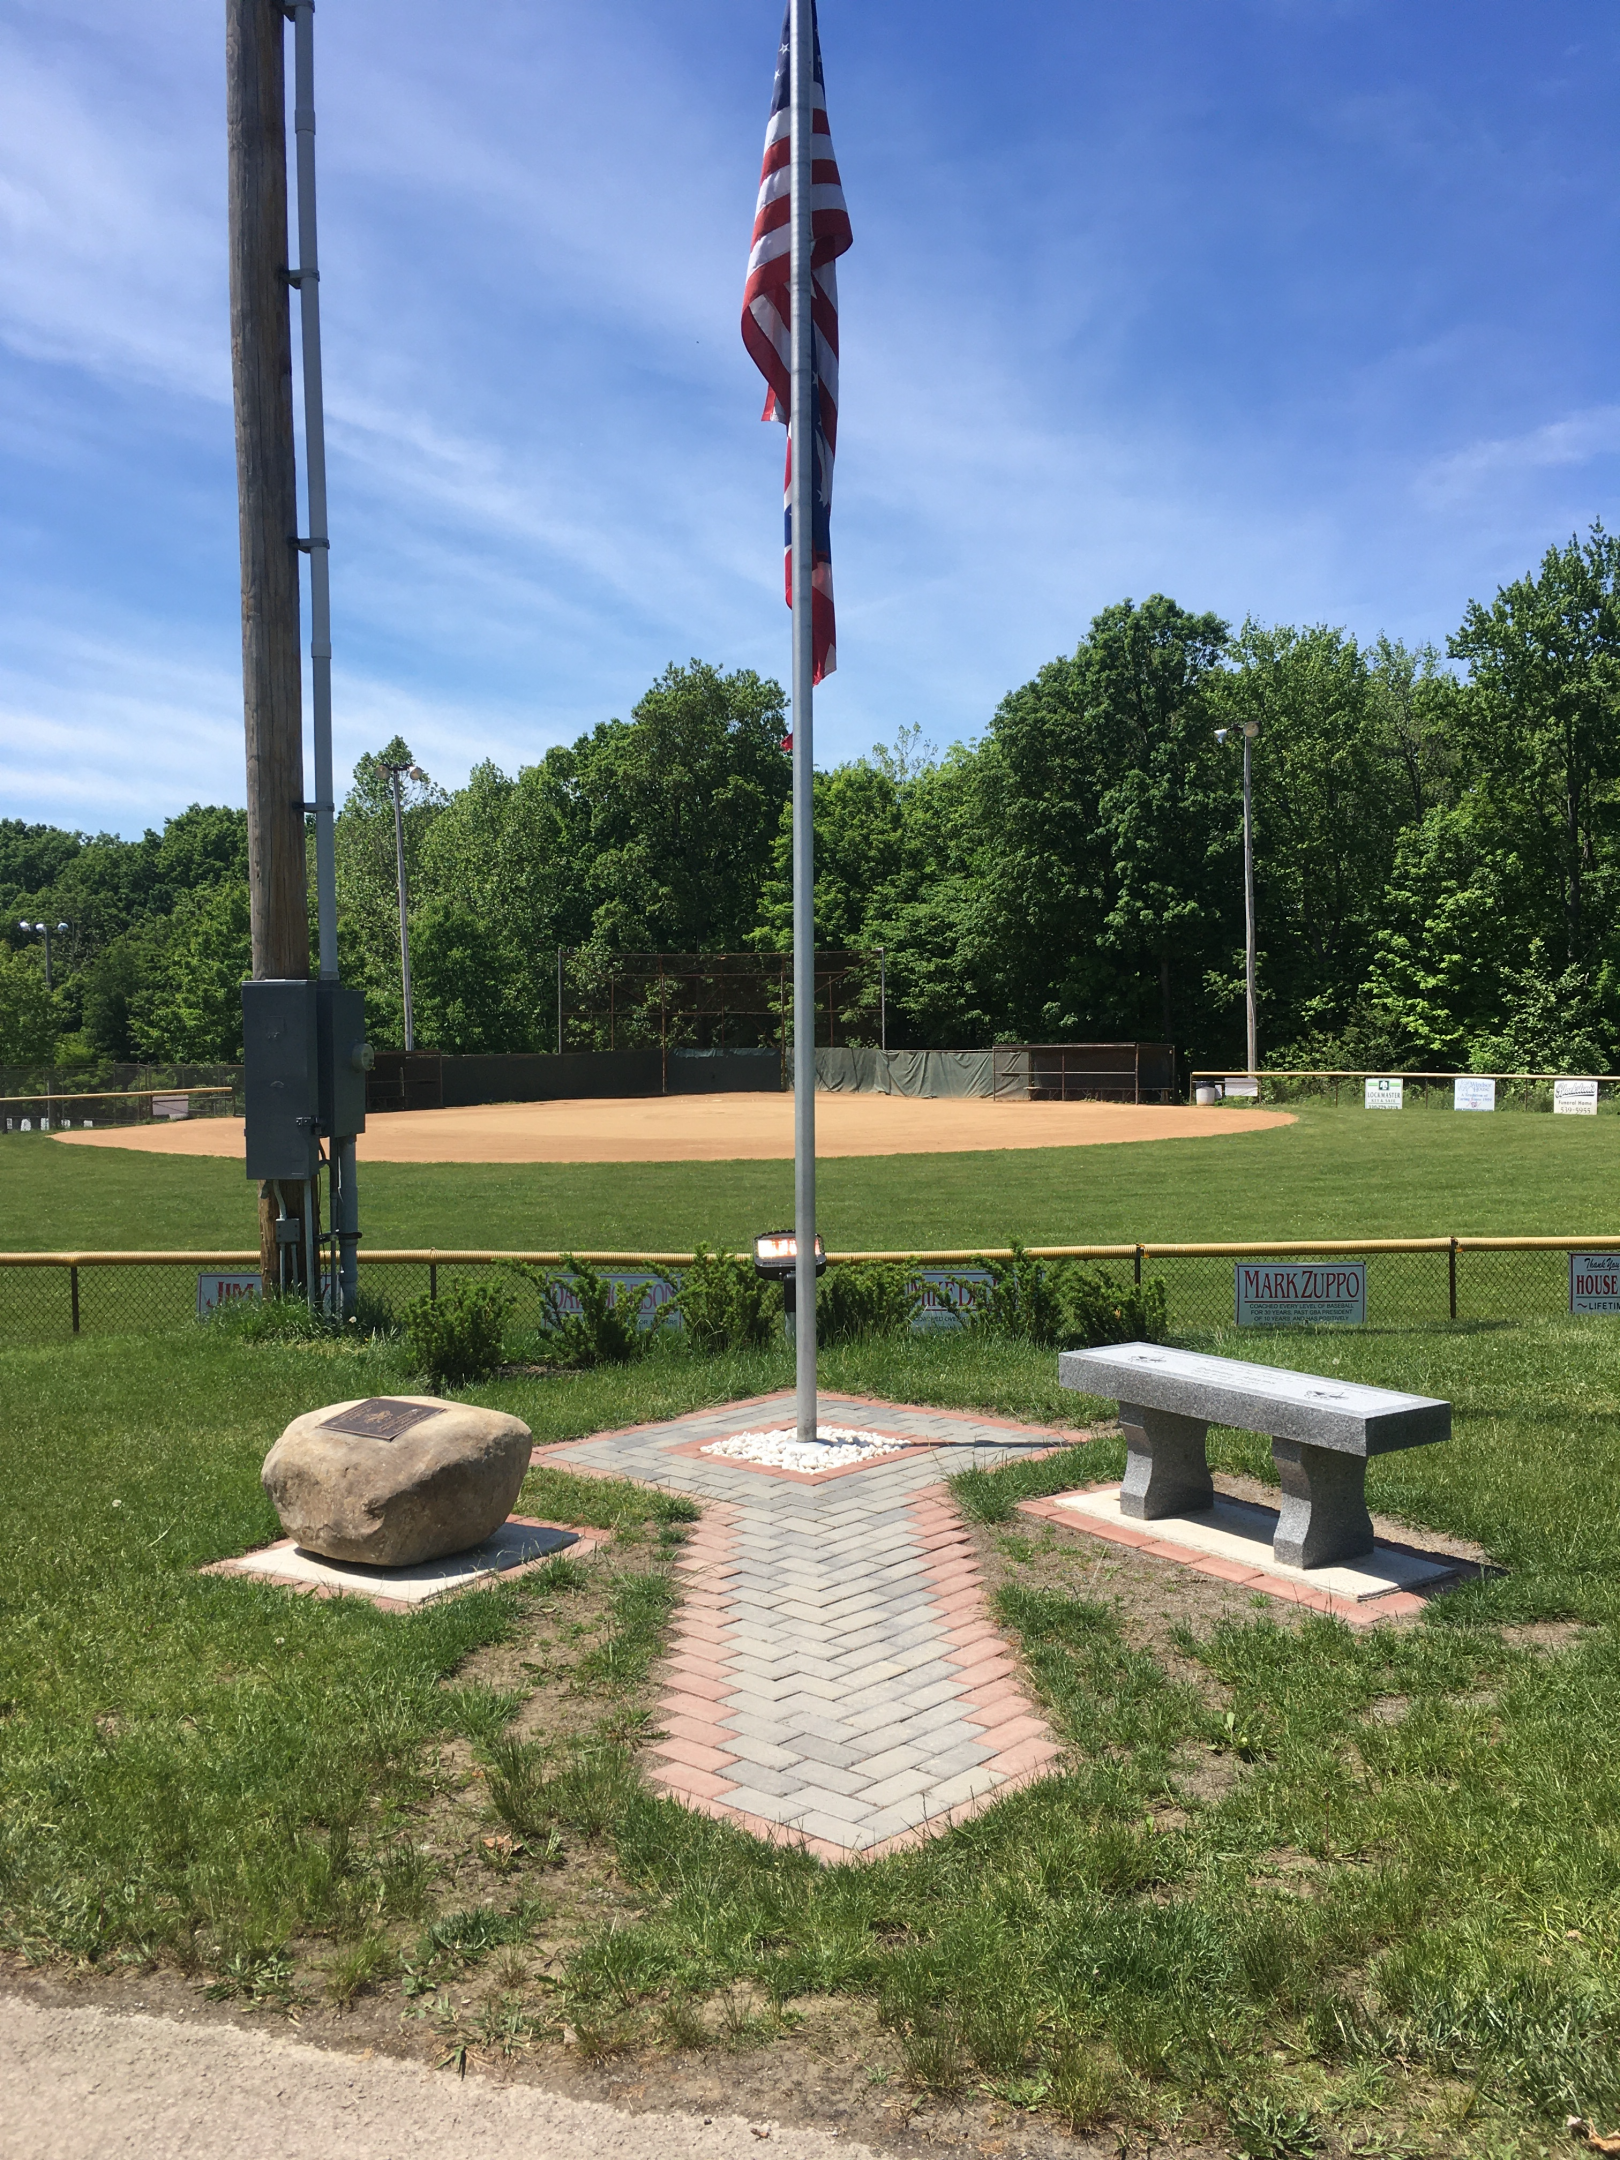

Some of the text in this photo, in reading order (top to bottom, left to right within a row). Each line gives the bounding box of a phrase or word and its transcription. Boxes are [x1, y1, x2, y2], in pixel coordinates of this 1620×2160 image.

[1584, 1257, 1620, 1271] Thank You
[1244, 1270, 1359, 1298] MARK ZUPPO
[1576, 1275, 1619, 1295] HOUSE
